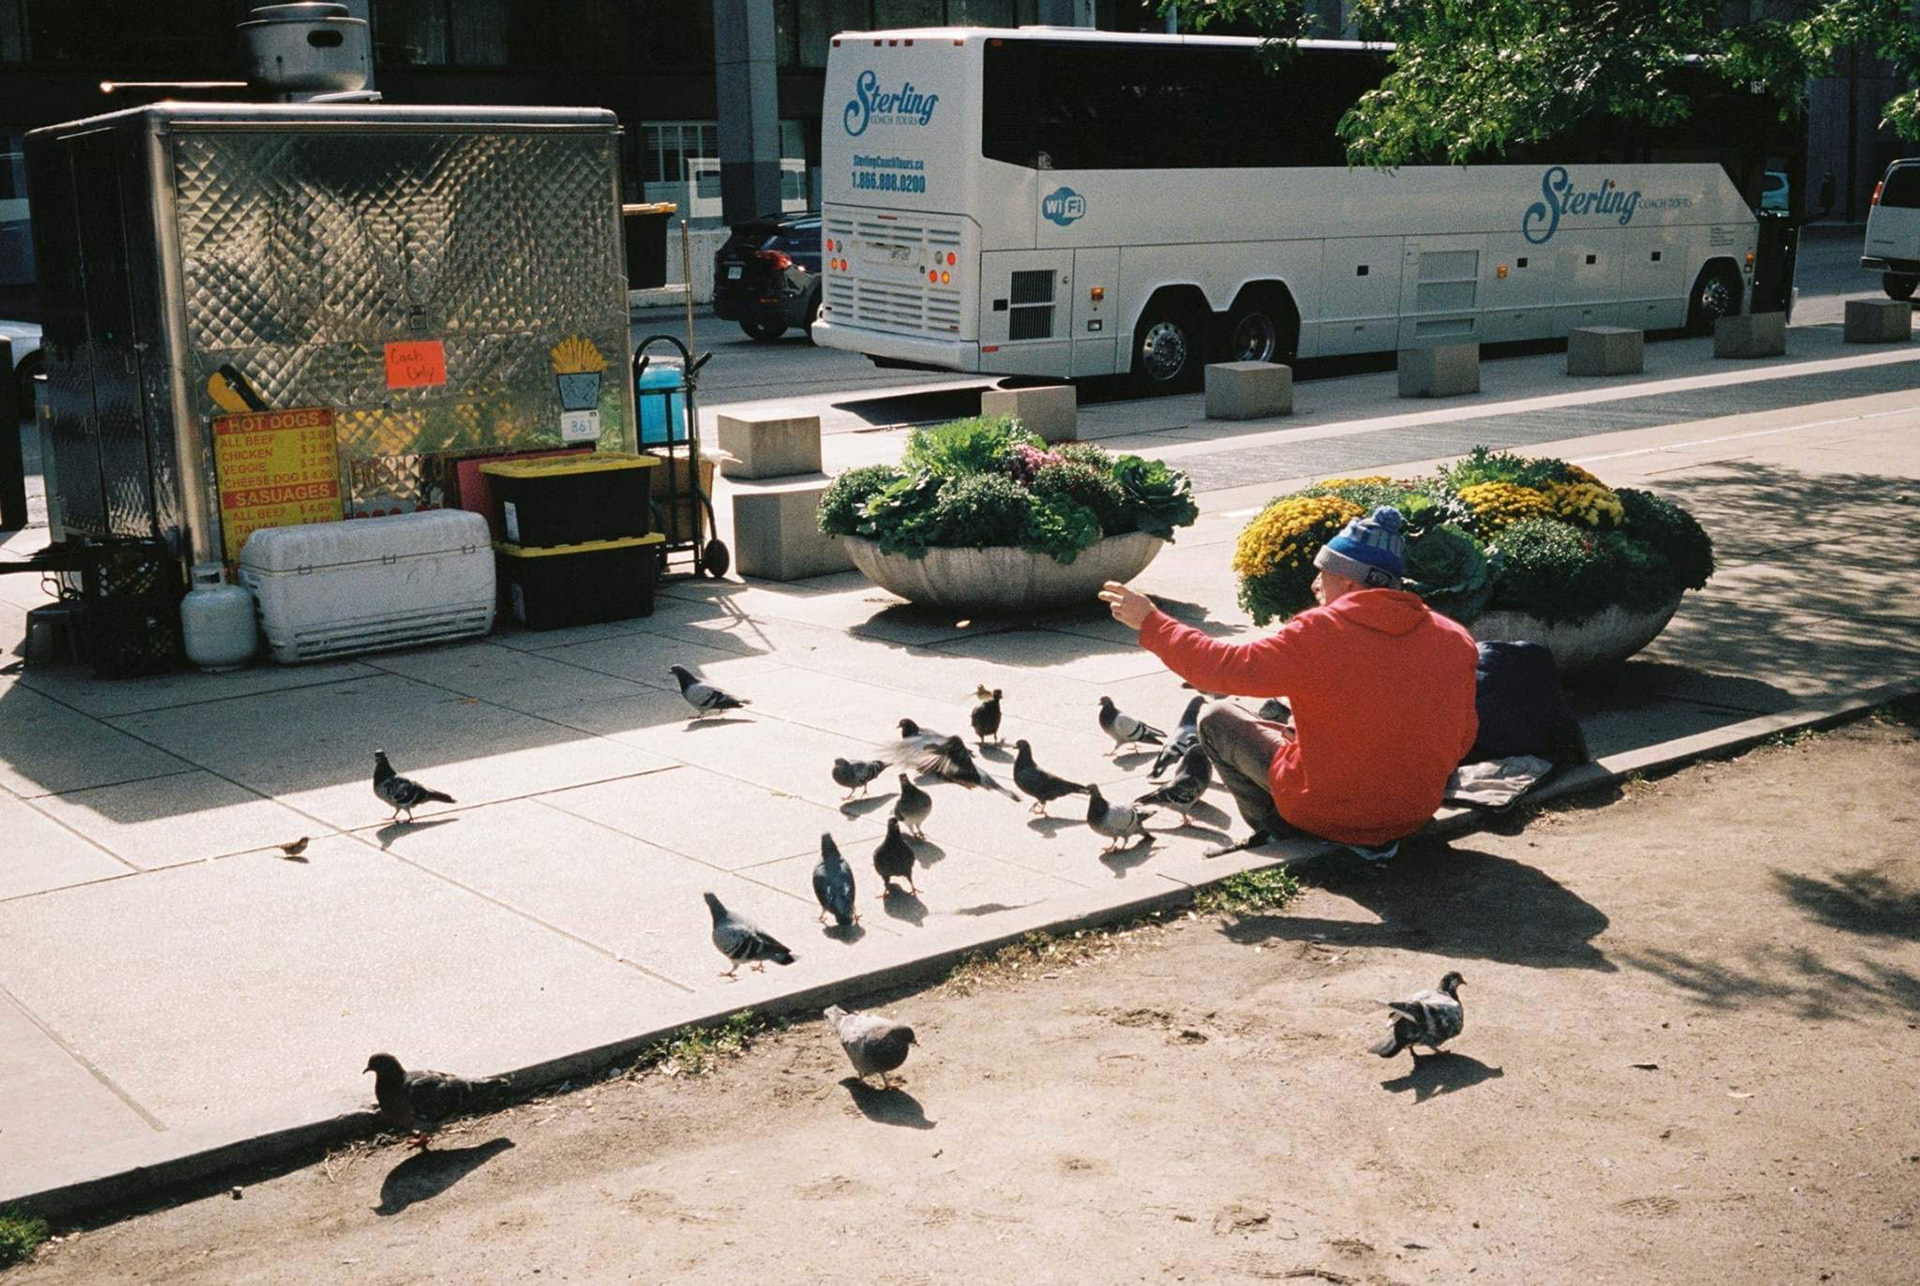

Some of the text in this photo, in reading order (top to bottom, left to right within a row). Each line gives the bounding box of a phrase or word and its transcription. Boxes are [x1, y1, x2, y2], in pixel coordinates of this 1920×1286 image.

[844, 70, 939, 136] Sterling
[851, 171, 926, 193] 1.866.808.0200
[1522, 166, 1641, 244] Sterling
[229, 412, 320, 432] HOT DOGS
[220, 437, 241, 448] ALL
[245, 434, 276, 447] BEEF
[222, 449, 274, 461] CHICKEN
[223, 462, 267, 475] VEGGIE
[225, 474, 270, 488] CHEESE
[274, 472, 299, 483] DOG
[235, 482, 330, 506] SASUAGES
[233, 511, 254, 521] ALL
[257, 508, 286, 519] BEEF
